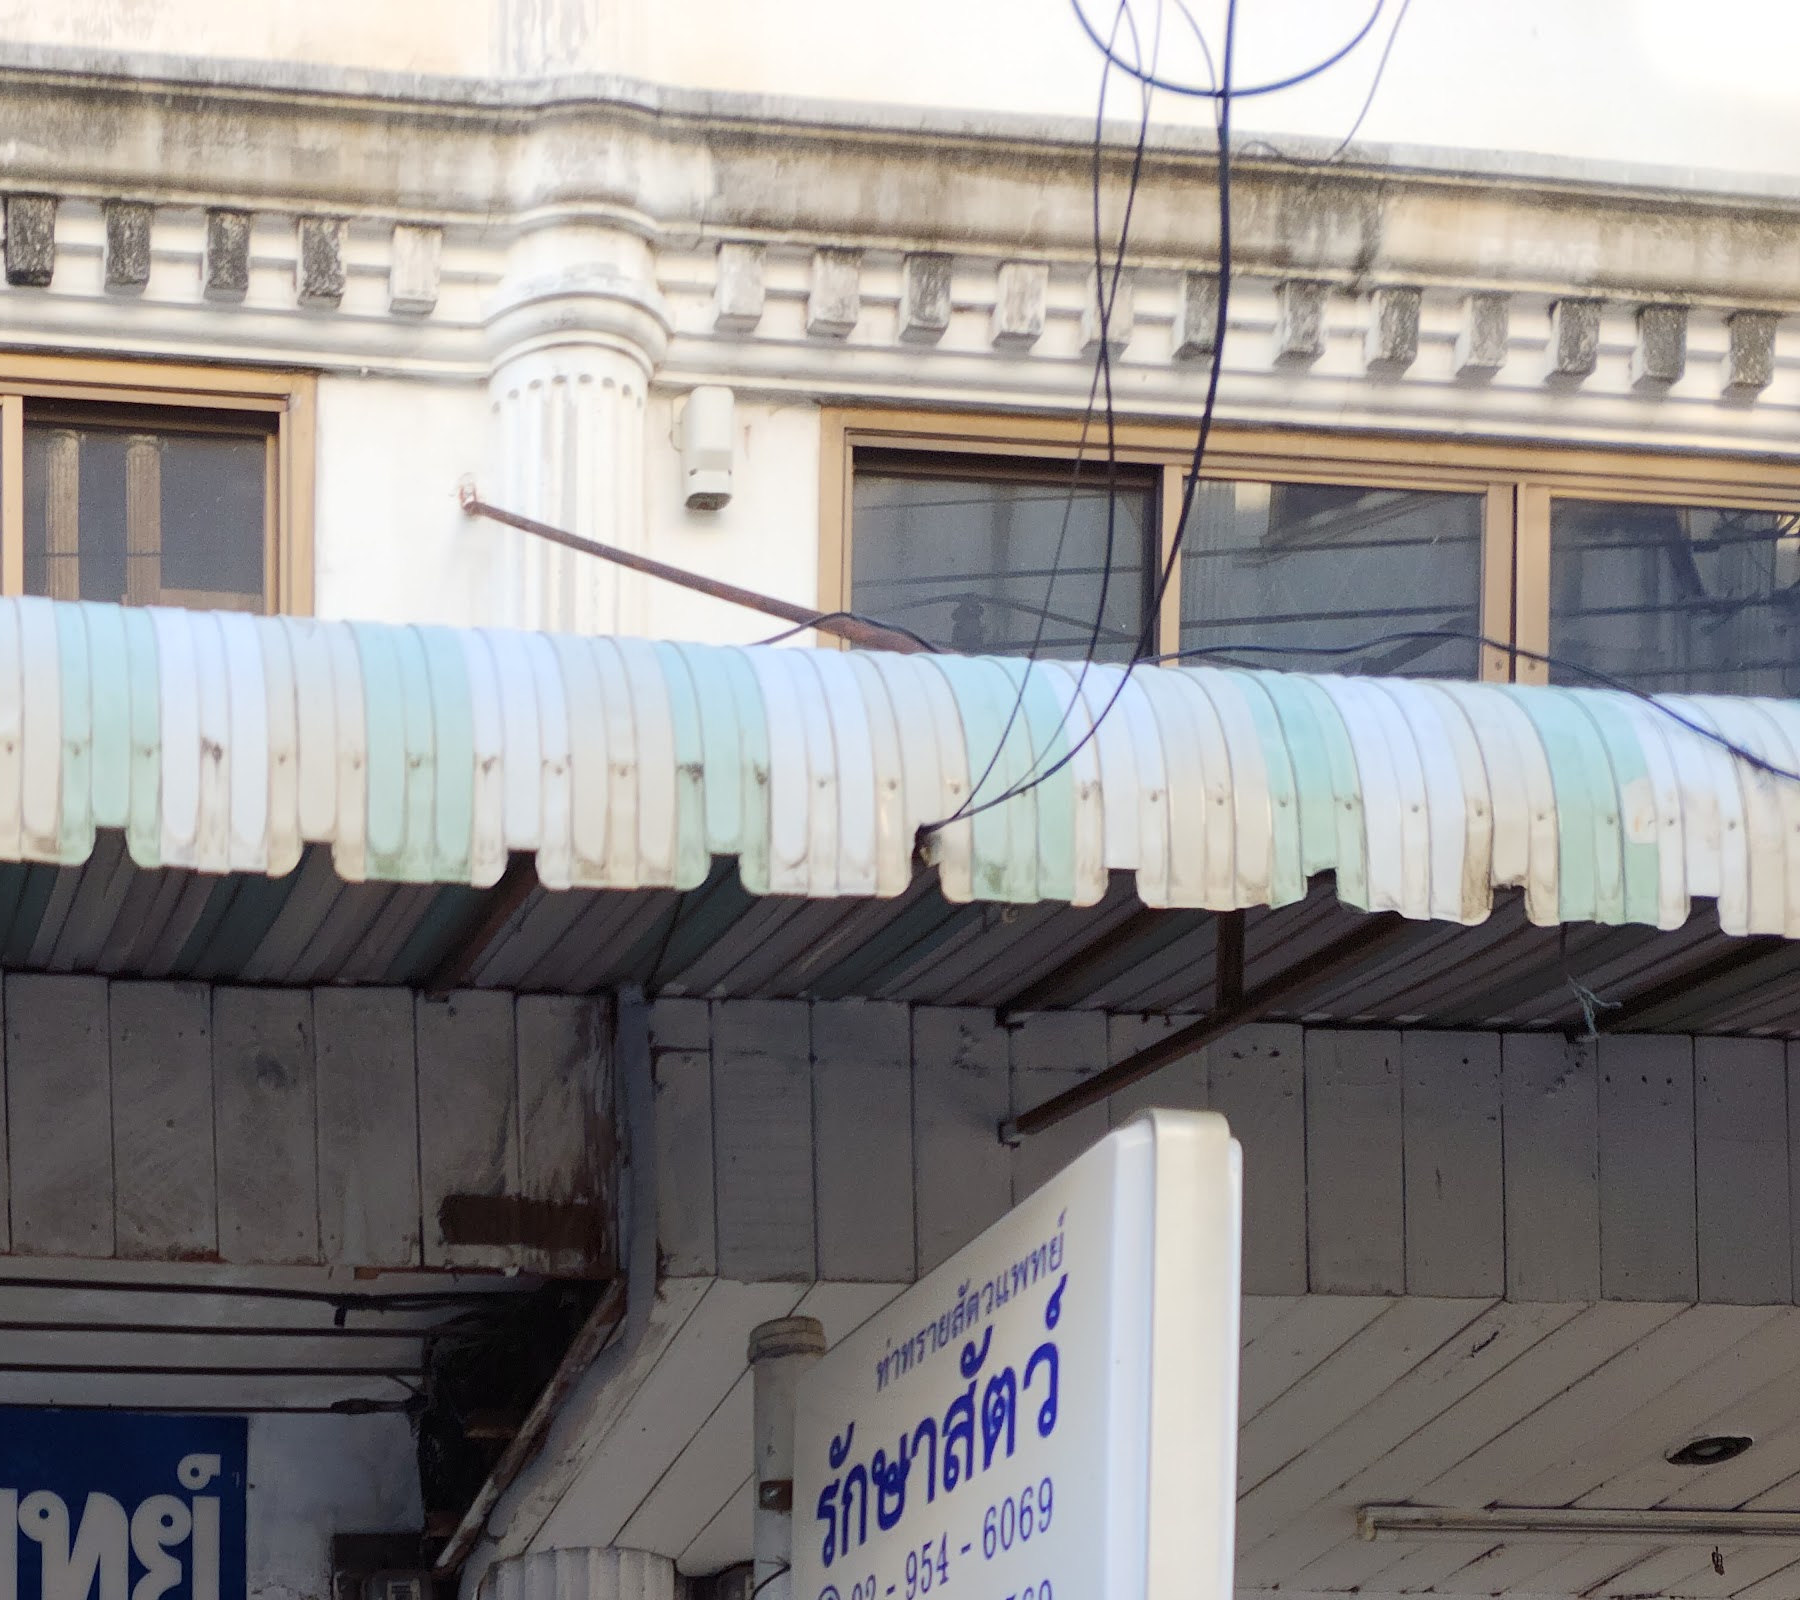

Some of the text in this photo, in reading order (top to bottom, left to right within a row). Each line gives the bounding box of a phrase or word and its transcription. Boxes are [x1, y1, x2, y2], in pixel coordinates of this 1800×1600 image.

[876, 1207, 1067, 1392] ท่าทรายสัตวแพทย์
[816, 1273, 1068, 1568] รักษาสัตว์
